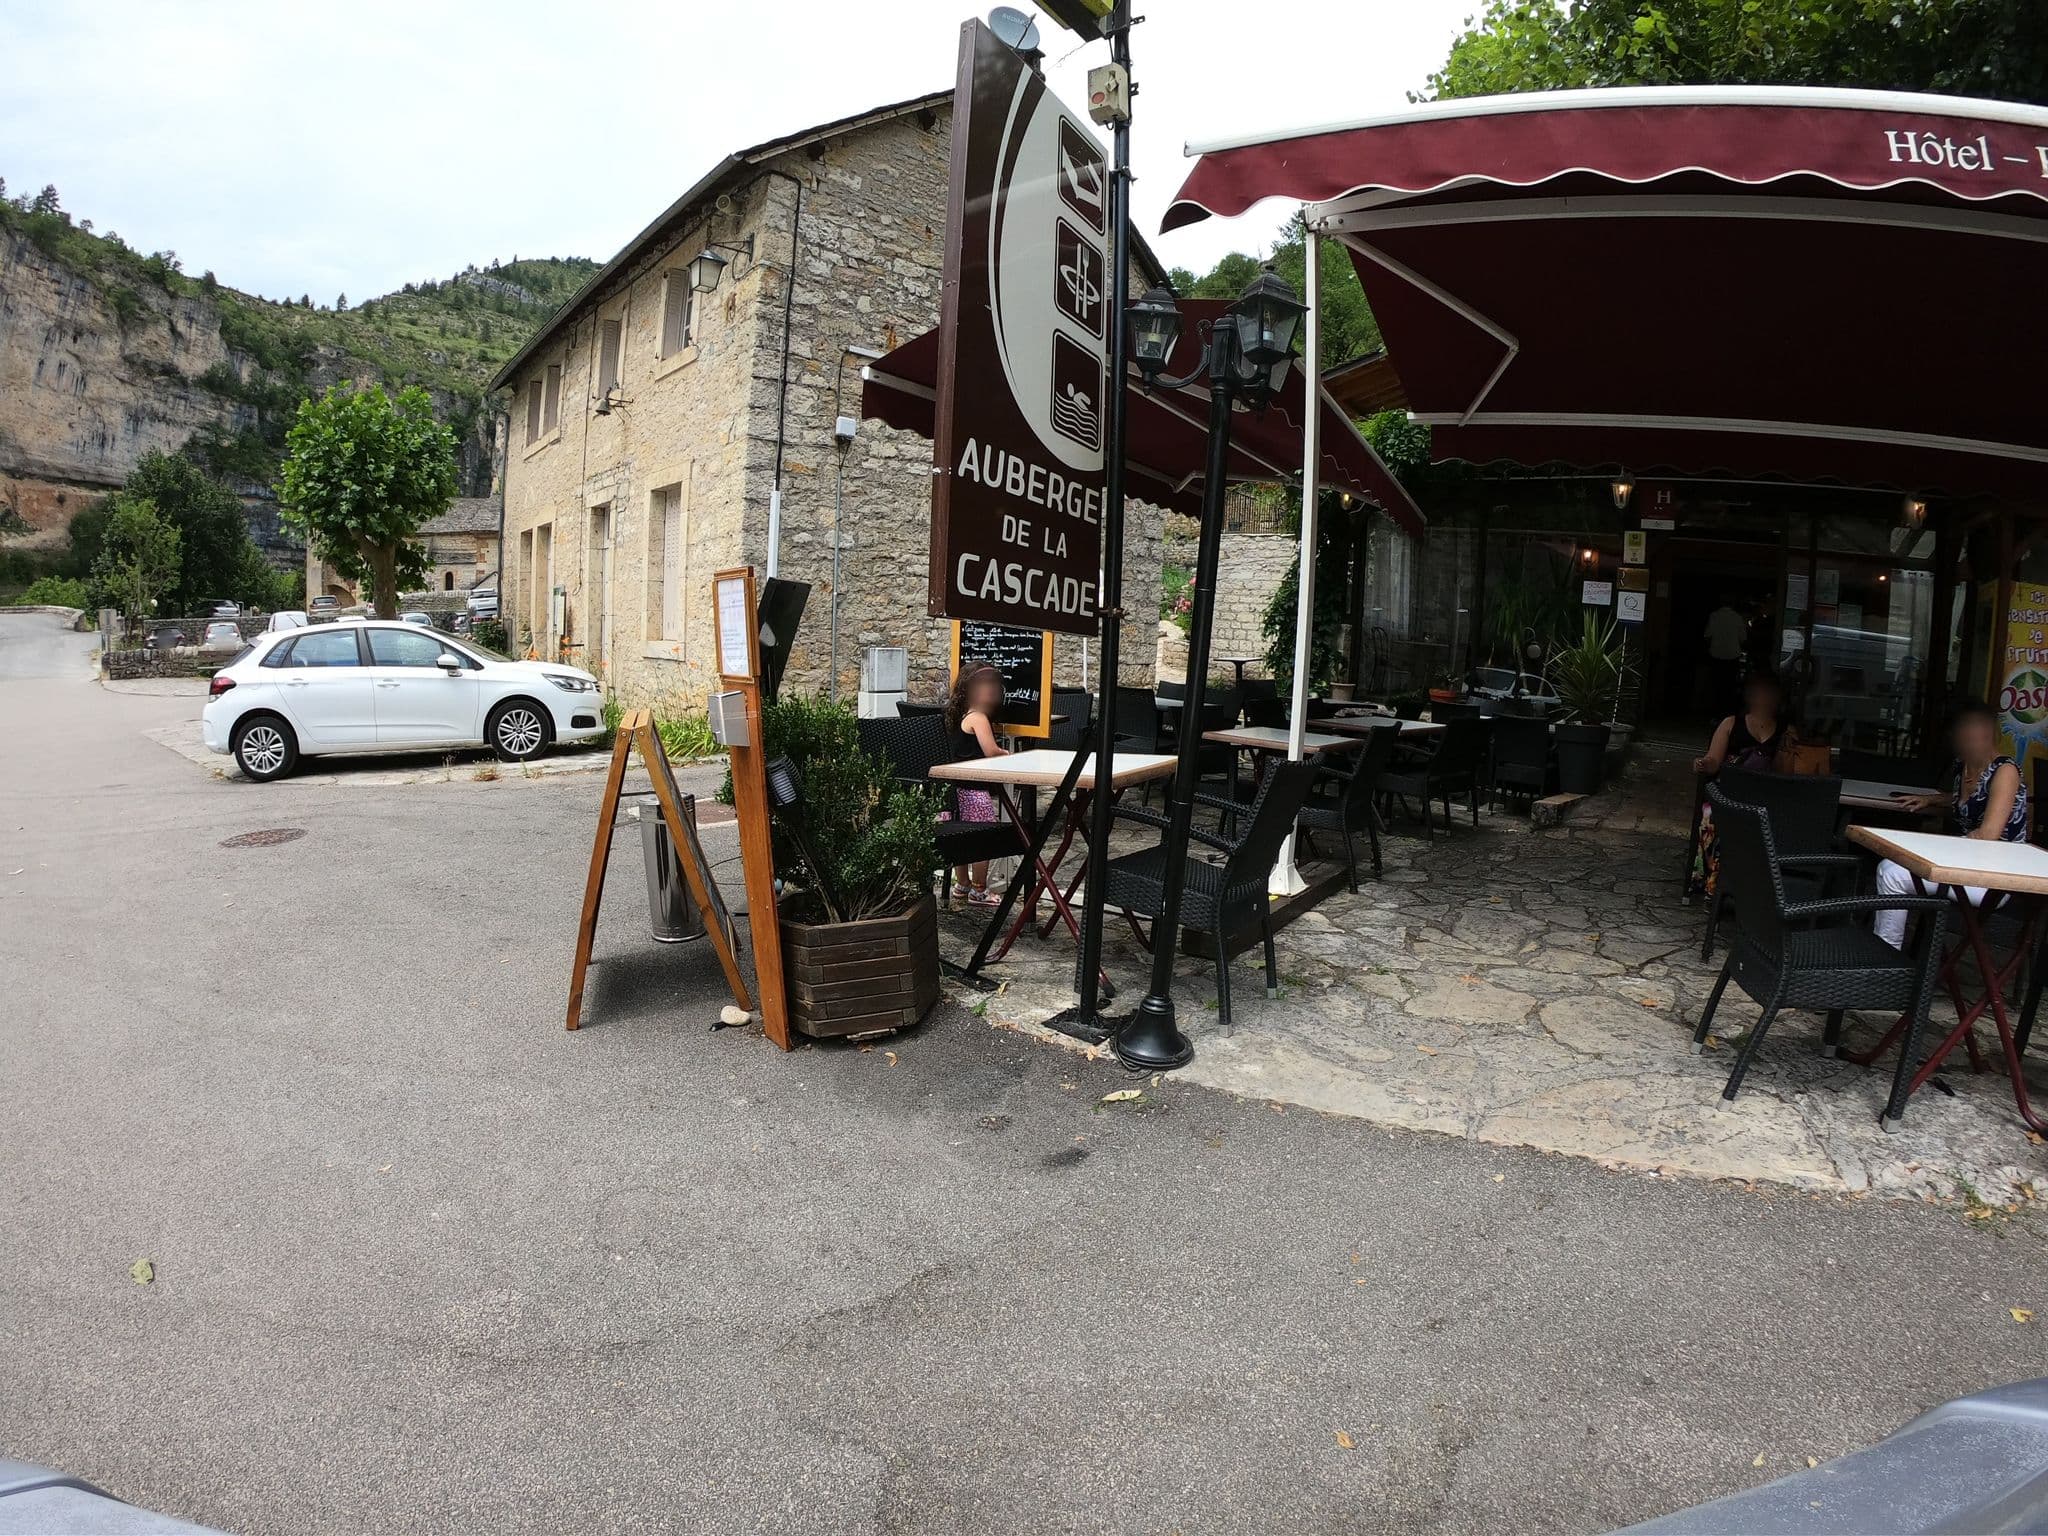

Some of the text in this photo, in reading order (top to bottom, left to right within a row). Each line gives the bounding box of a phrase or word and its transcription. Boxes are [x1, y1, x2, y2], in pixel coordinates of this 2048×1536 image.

[1884, 131, 1994, 171] Hôtel
[958, 437, 1100, 525] AUBERGE
[1002, 514, 1067, 558] DE LA
[957, 552, 1096, 617] CASCADE
